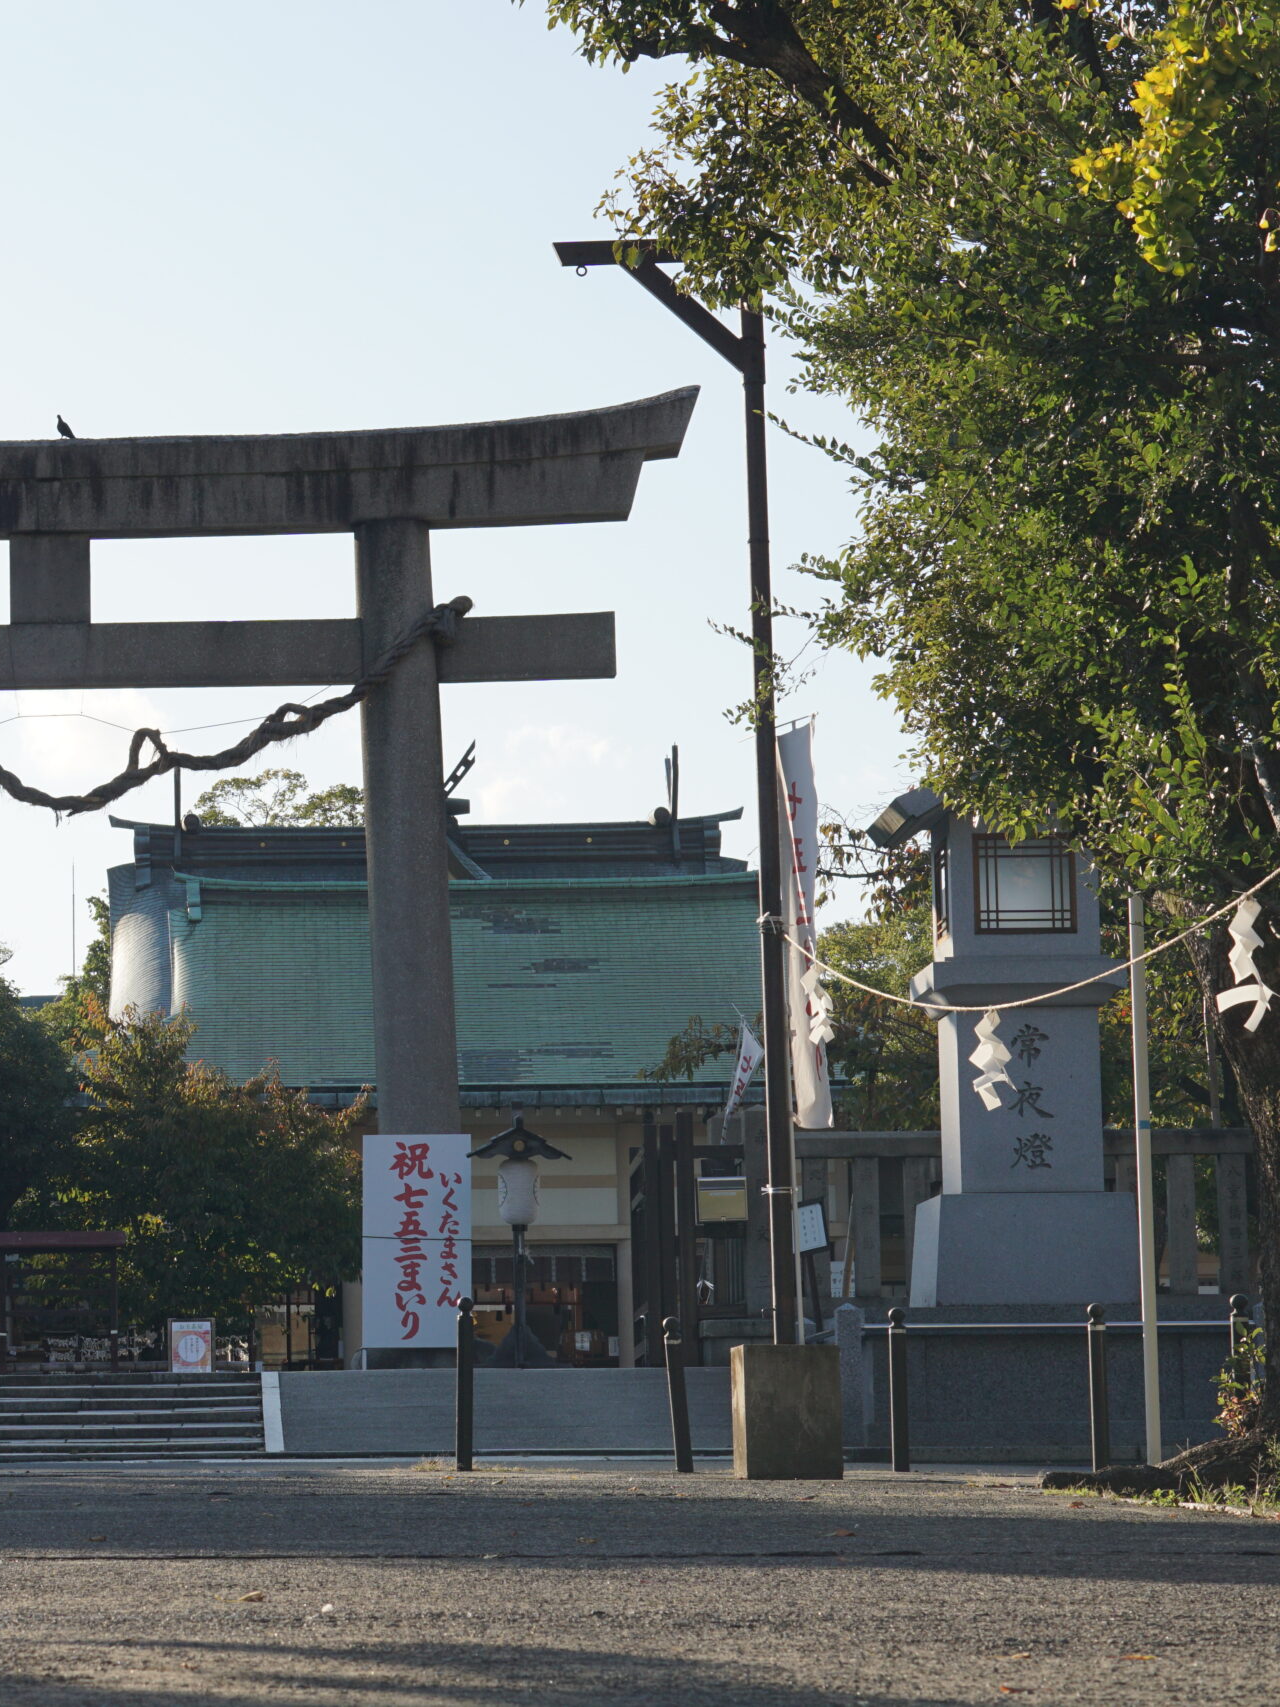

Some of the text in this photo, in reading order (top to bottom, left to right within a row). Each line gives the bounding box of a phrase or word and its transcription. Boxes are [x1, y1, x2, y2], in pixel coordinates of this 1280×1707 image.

[1008, 1024, 1055, 1169] 常夜燈
[390, 1142, 434, 1340] 祝七五三まいり
[437, 1172, 462, 1308] いくたまさん
